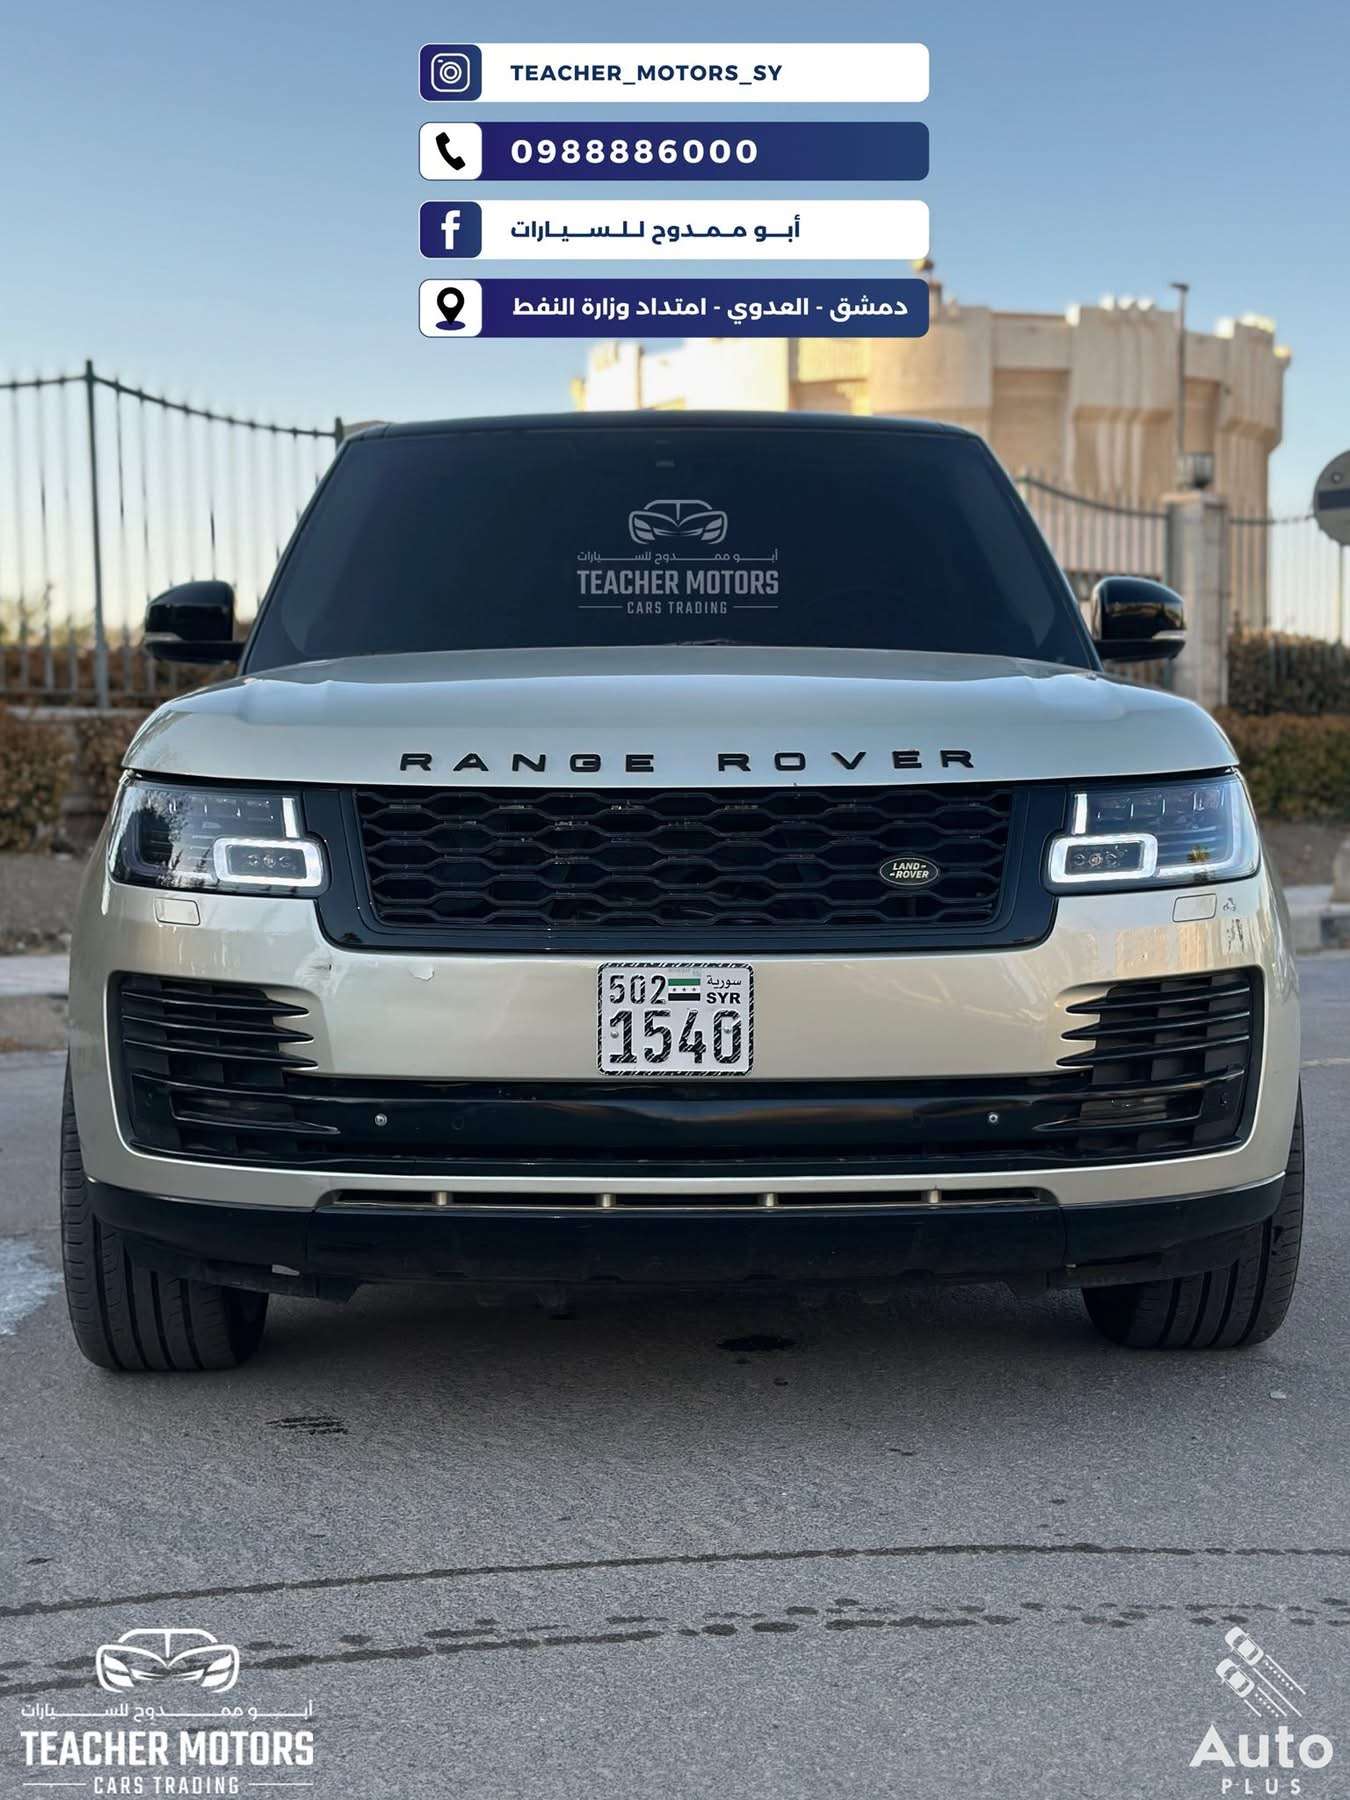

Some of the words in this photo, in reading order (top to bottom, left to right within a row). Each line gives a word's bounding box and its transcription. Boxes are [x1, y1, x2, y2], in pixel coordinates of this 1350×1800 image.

[400, 753, 655, 773] RANGE
[717, 750, 976, 773] ROVER
[609, 974, 667, 1005] 502
[706, 975, 742, 990] سورية
[706, 992, 741, 1004] SYR
[609, 1009, 742, 1064] 1540
